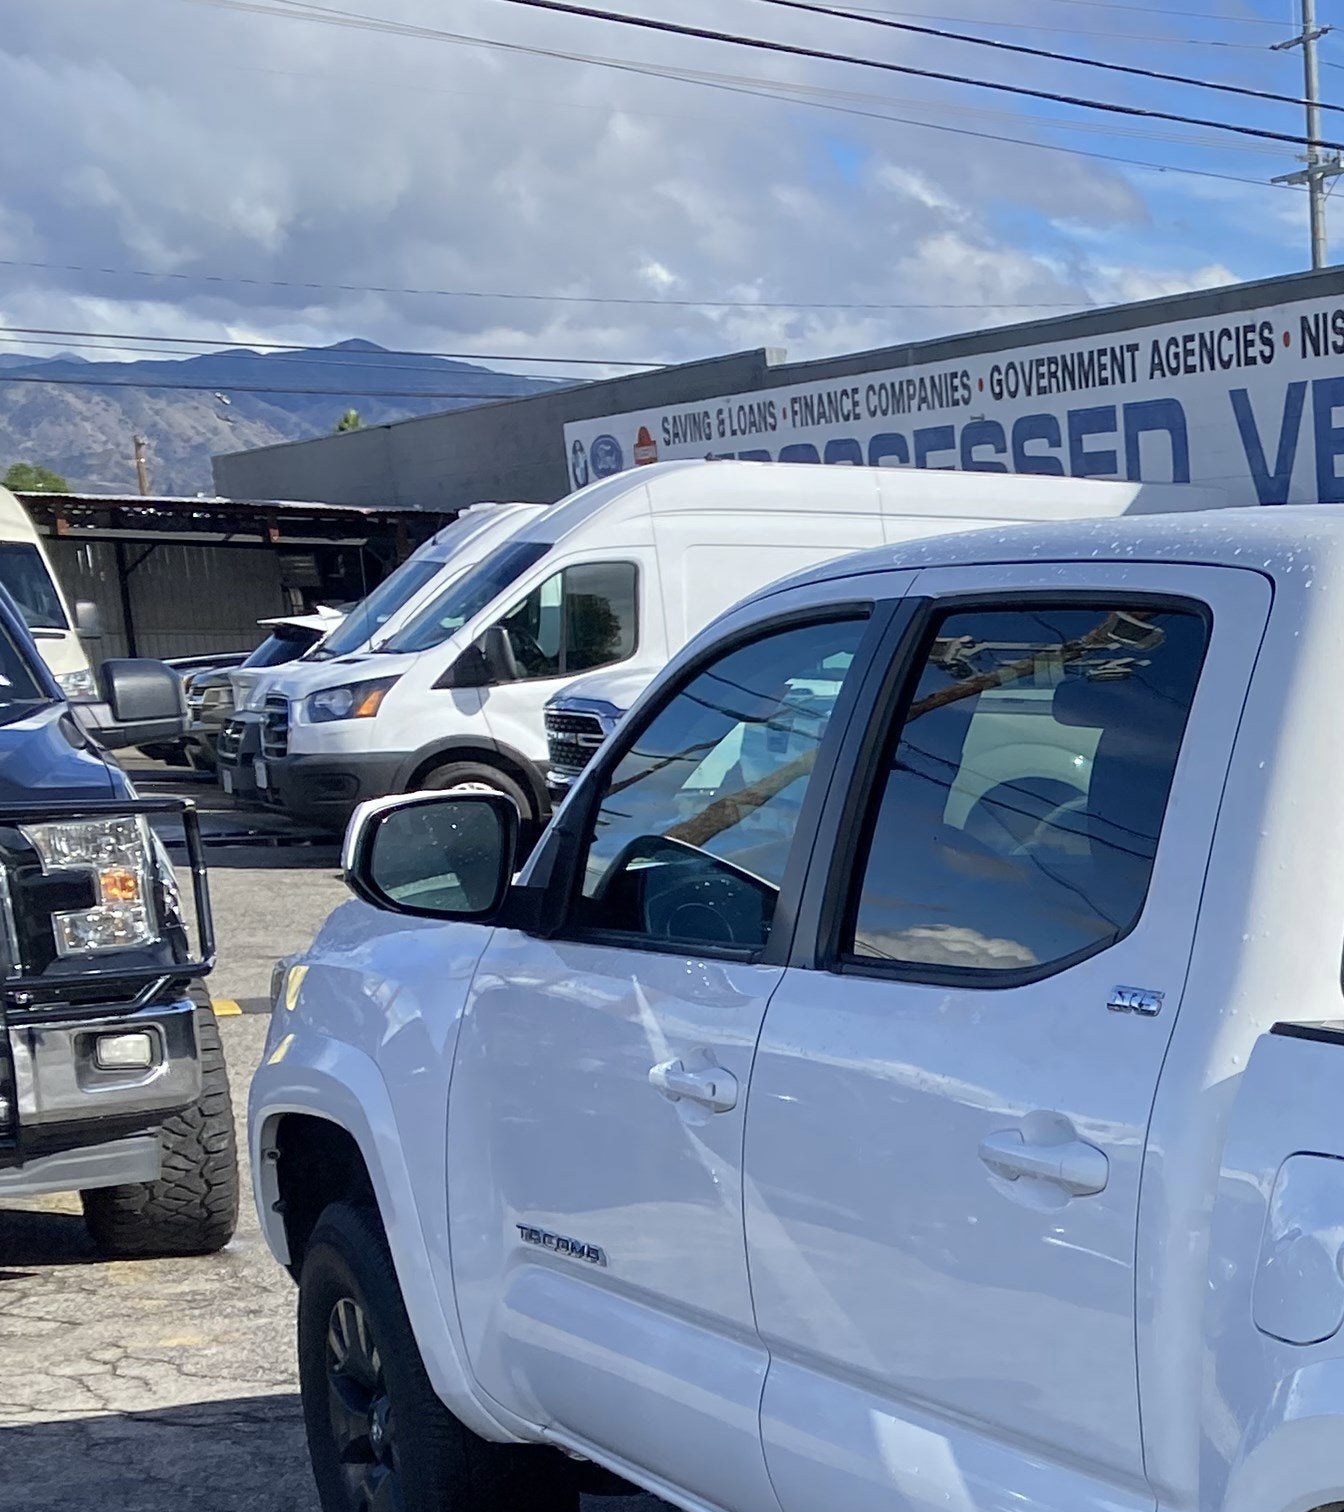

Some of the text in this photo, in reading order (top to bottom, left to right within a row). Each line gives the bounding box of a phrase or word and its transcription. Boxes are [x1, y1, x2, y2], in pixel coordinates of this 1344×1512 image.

[661, 411, 712, 446] SAVING
[716, 411, 726, 439] &
[728, 400, 778, 437] LOANS
[790, 387, 861, 428] FINANCE
[865, 369, 972, 418] COMPANIES
[990, 342, 1140, 401] GOVERNMENT
[1149, 321, 1275, 380] AGENCIES
[515, 1222, 608, 1267] TACOMA
